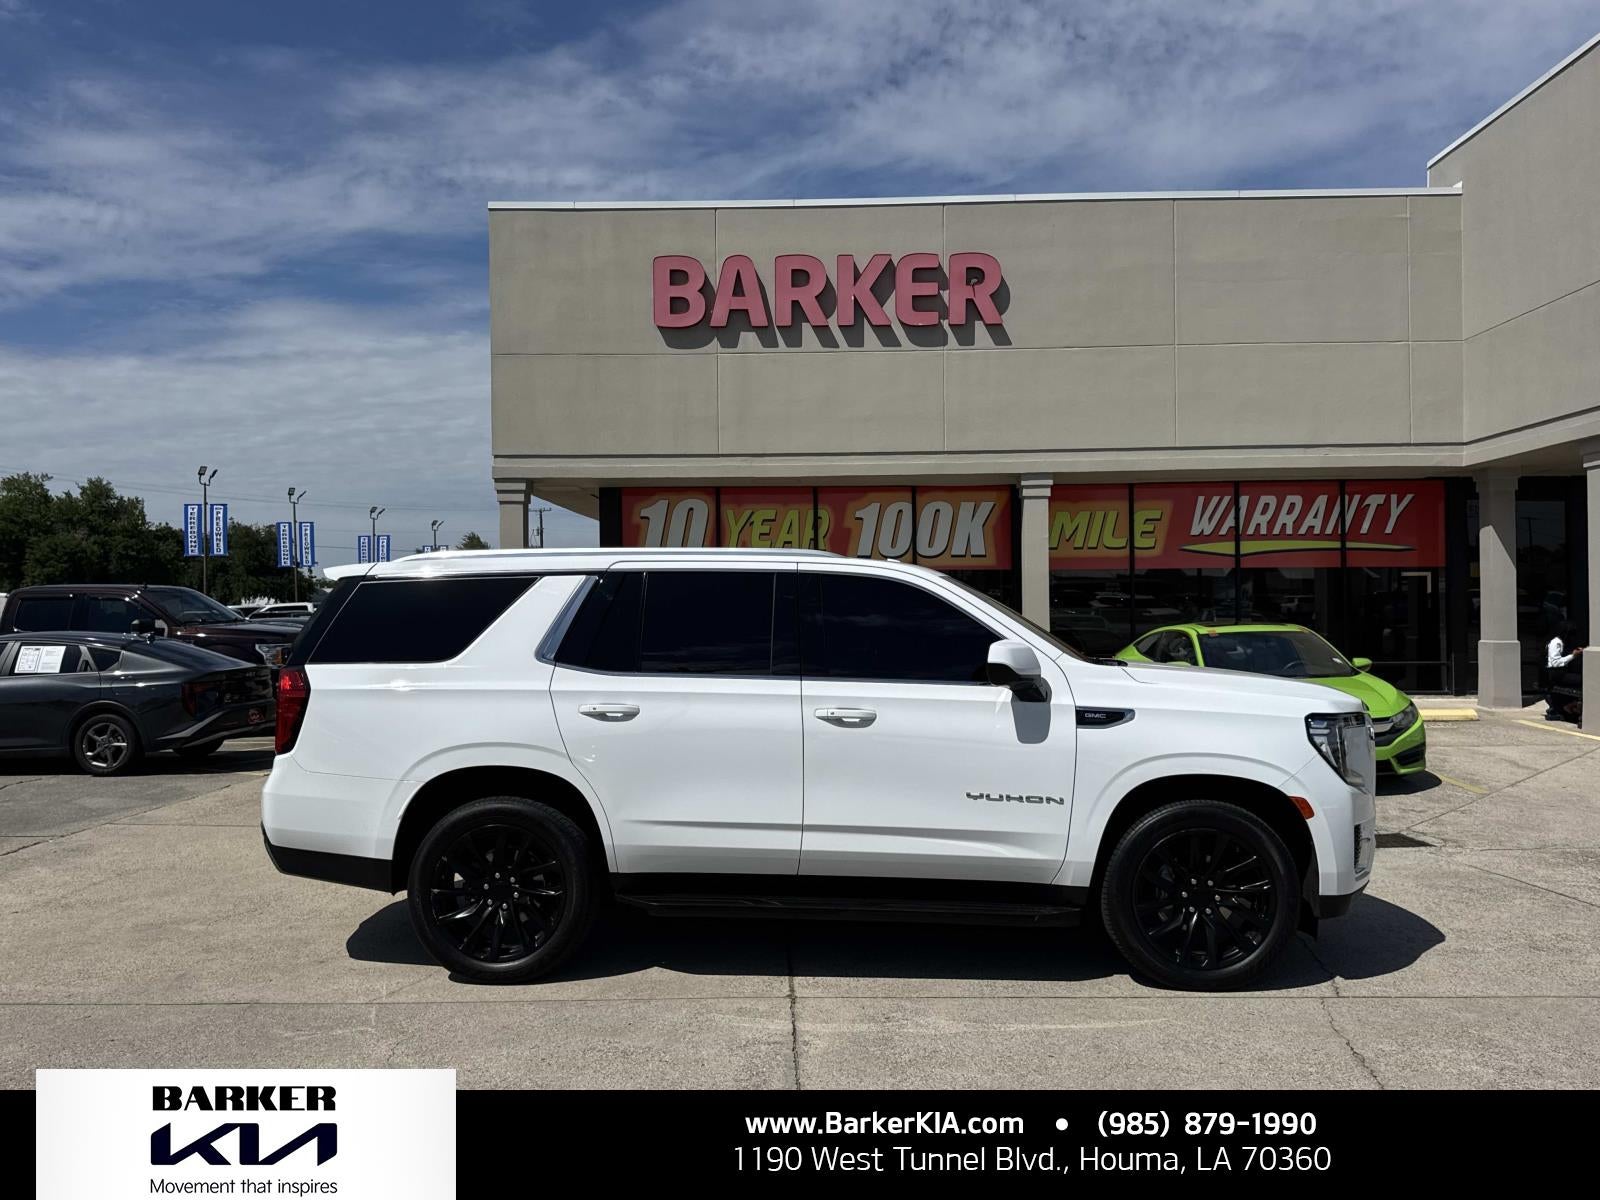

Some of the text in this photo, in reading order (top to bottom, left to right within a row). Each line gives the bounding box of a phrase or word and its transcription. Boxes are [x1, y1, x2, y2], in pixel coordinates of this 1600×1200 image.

[652, 252, 1003, 328] BARKER
[640, 499, 1163, 558] 10 YEAR 100K MILE
[1189, 494, 1415, 536] WARRANTY
[965, 792, 1065, 806] YUKON
